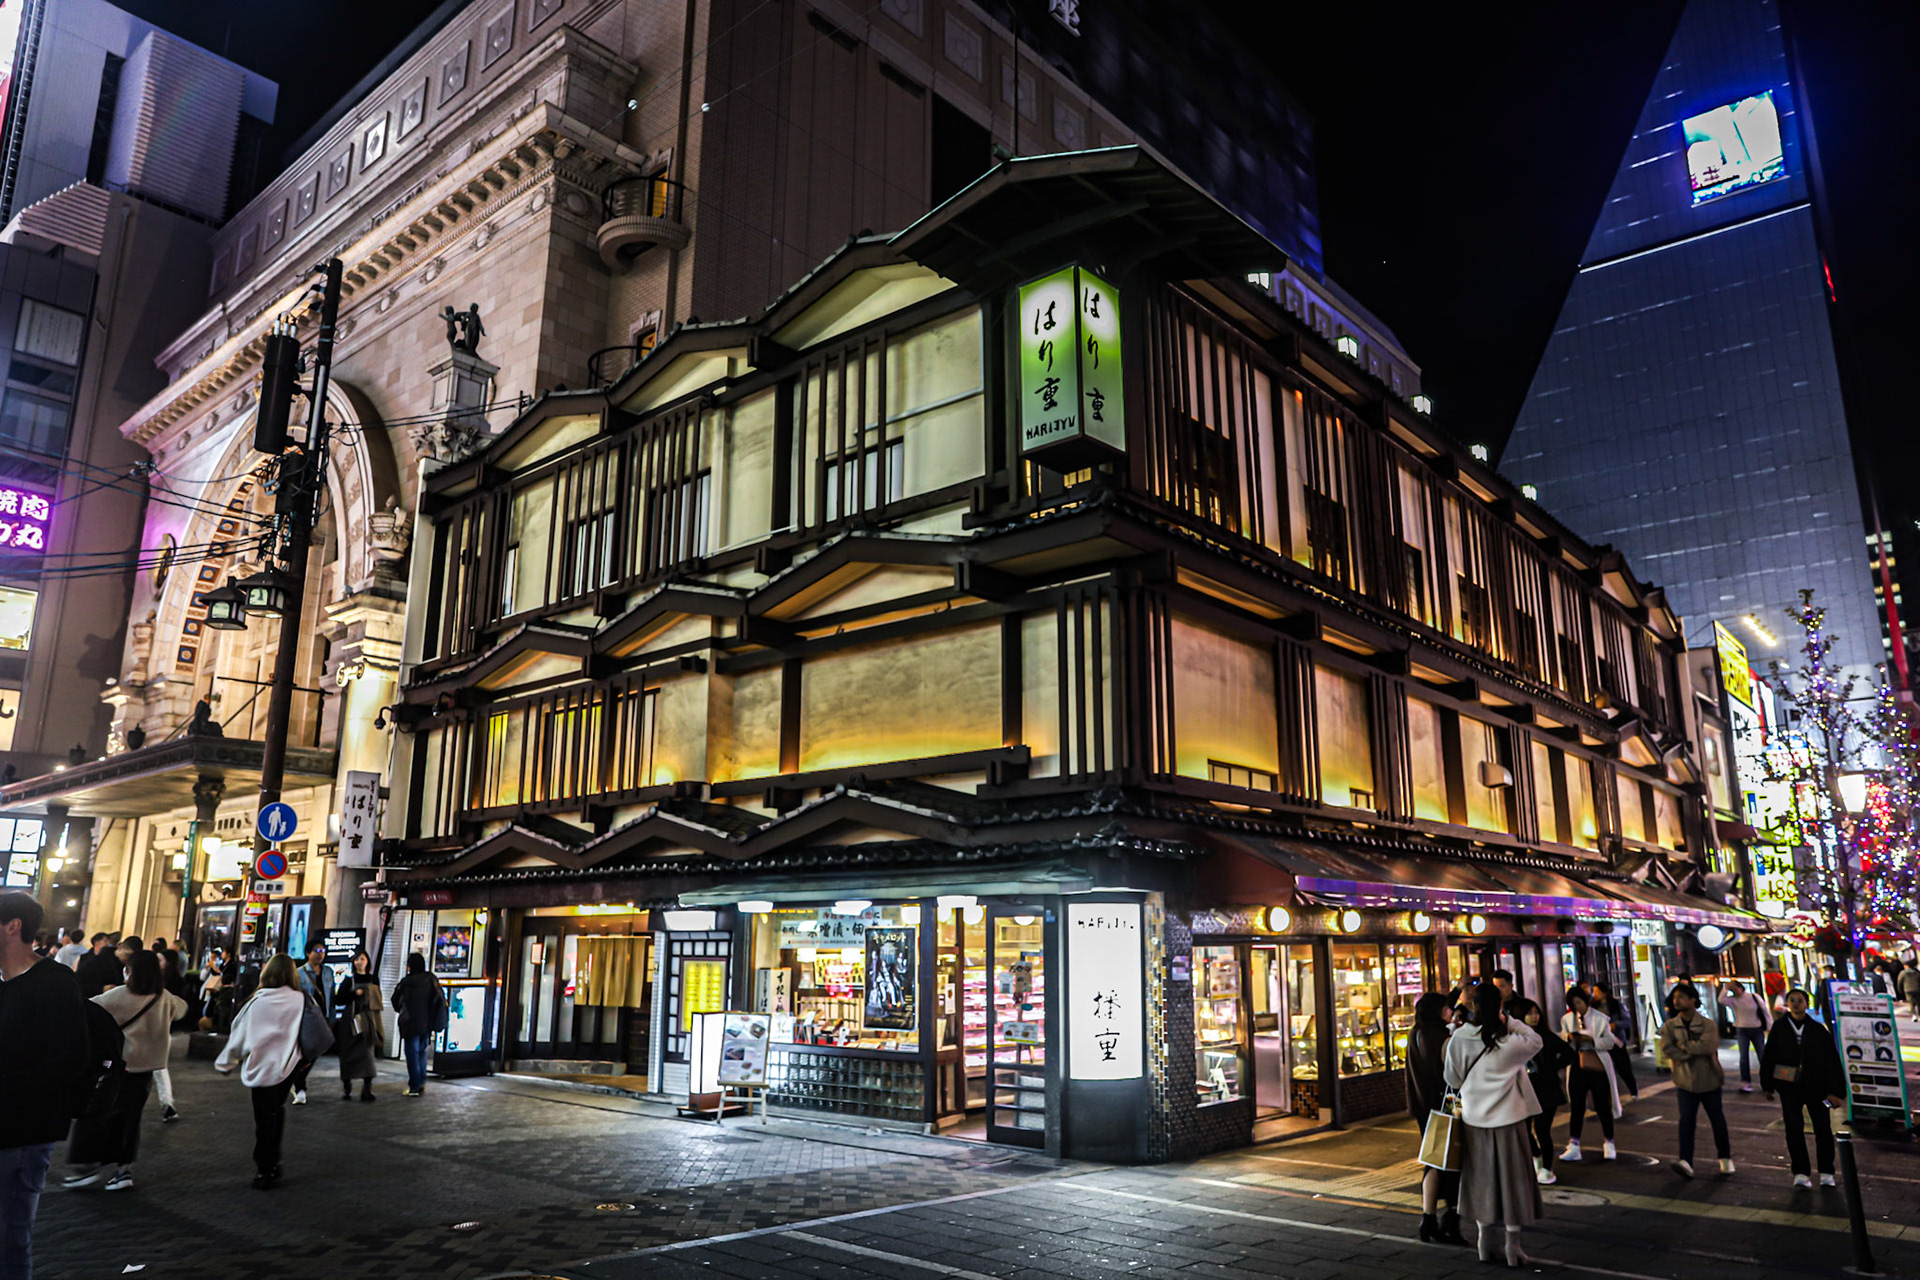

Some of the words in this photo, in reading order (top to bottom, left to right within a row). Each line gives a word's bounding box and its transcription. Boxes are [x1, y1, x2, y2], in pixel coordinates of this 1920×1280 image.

[1034, 300, 1061, 412] はり重
[1083, 287, 1105, 422] はり重
[1026, 415, 1076, 441] HARIJYU
